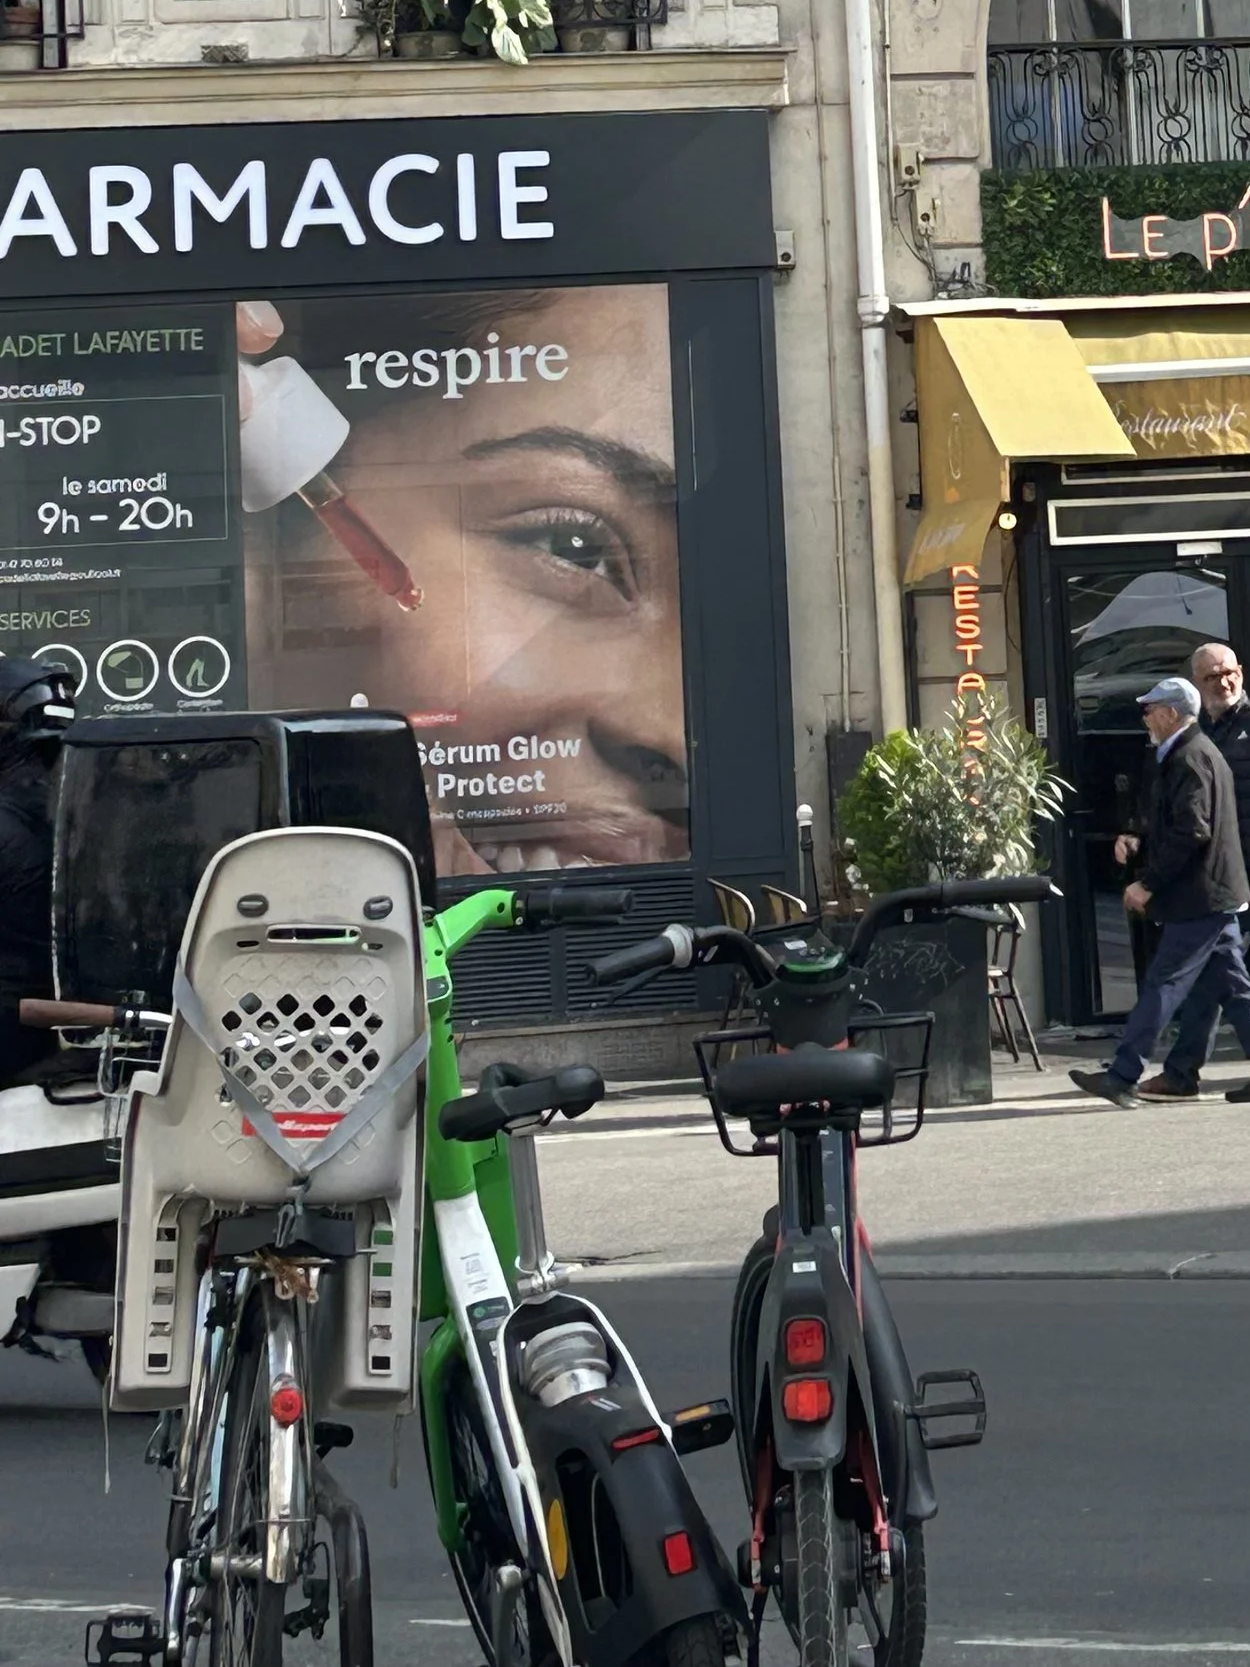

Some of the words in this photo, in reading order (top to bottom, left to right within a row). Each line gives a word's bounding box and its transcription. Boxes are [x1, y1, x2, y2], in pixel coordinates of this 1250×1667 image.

[0, 151, 554, 259] ARMACIE
[0, 334, 66, 358] ADET
[73, 329, 204, 354] LAFAYETTE
[344, 332, 569, 399] respire
[1114, 400, 1246, 438] estaurant
[62, 476, 82, 495] le
[88, 472, 167, 494] samedi
[37, 502, 80, 535] 9h
[118, 496, 193, 531] 20h
[0, 609, 91, 631] SERVICES
[417, 740, 501, 766] Sérum
[507, 735, 582, 761] Glow
[437, 770, 546, 798] Protect
